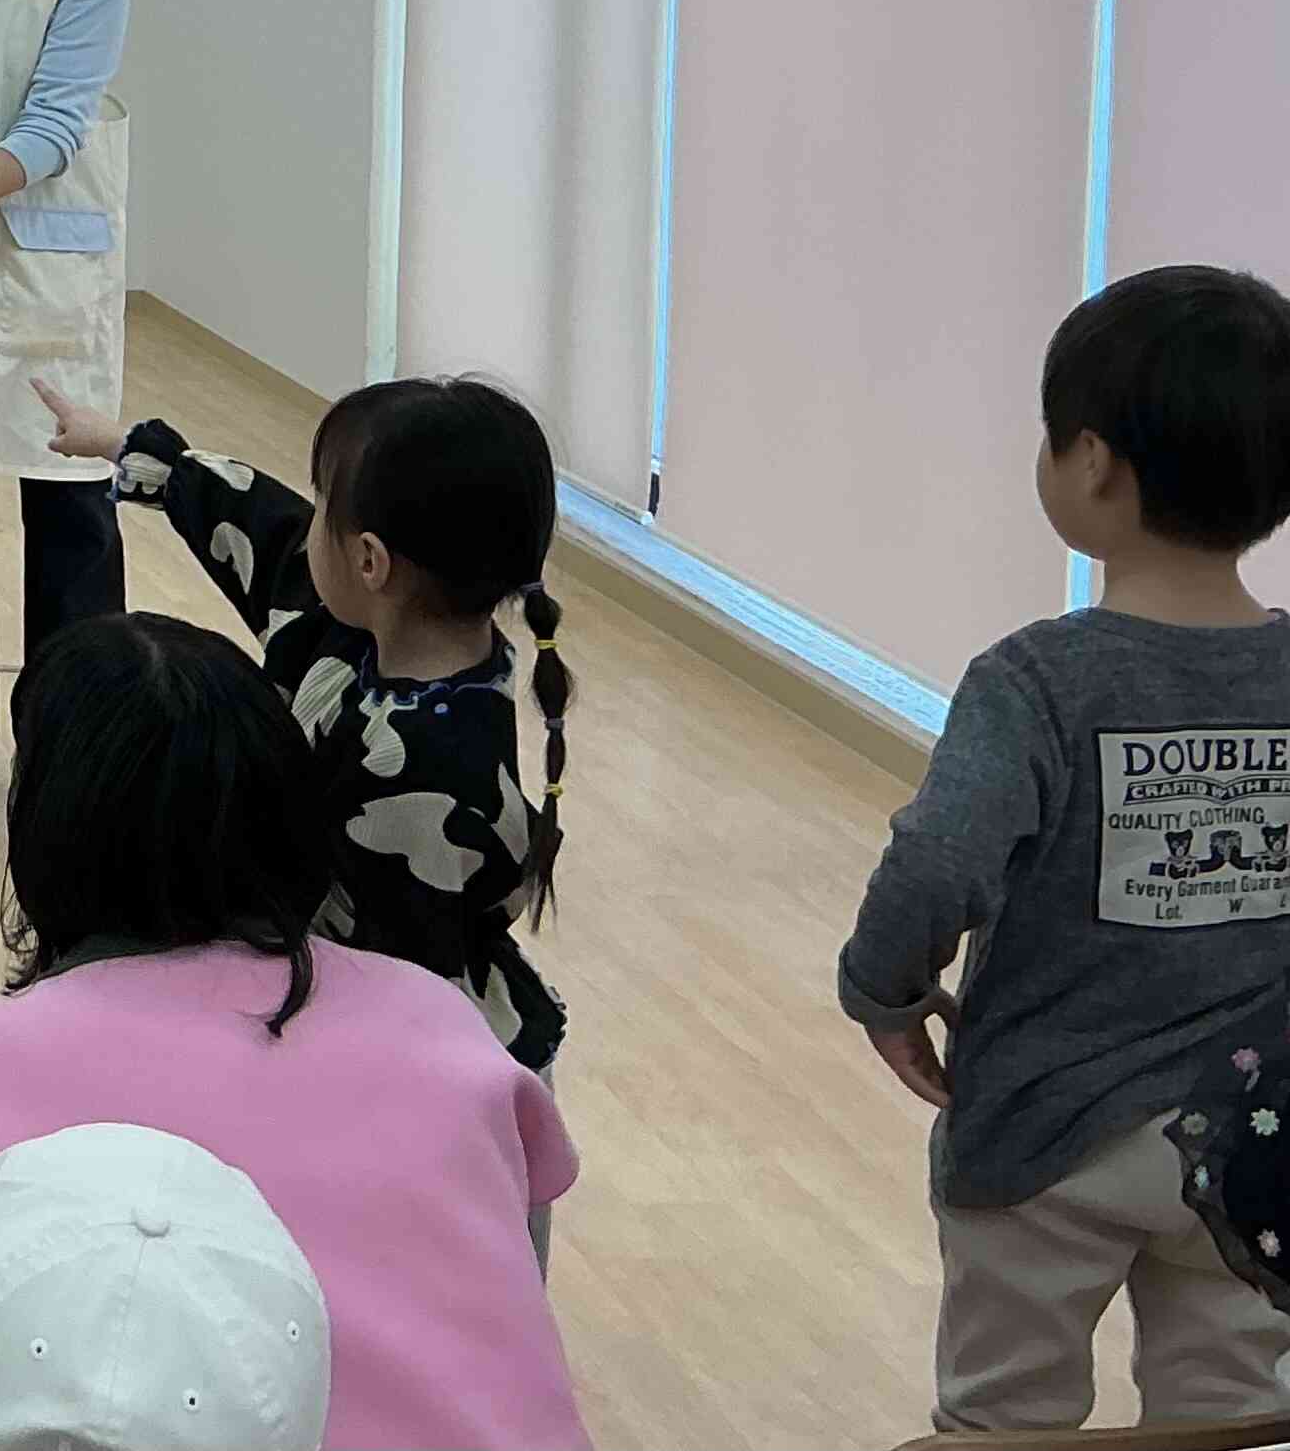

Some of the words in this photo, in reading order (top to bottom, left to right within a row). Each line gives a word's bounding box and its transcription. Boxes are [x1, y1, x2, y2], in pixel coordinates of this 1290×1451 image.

[1122, 738, 1288, 776] DOUBLE
[1130, 781, 1208, 799] CRAFTED
[1211, 780, 1262, 800] WITH
[1108, 812, 1183, 830] QUALITY
[1189, 806, 1265, 827] CLOTHING
[1125, 879, 1173, 902] Every
[1177, 878, 1236, 897] Garment
